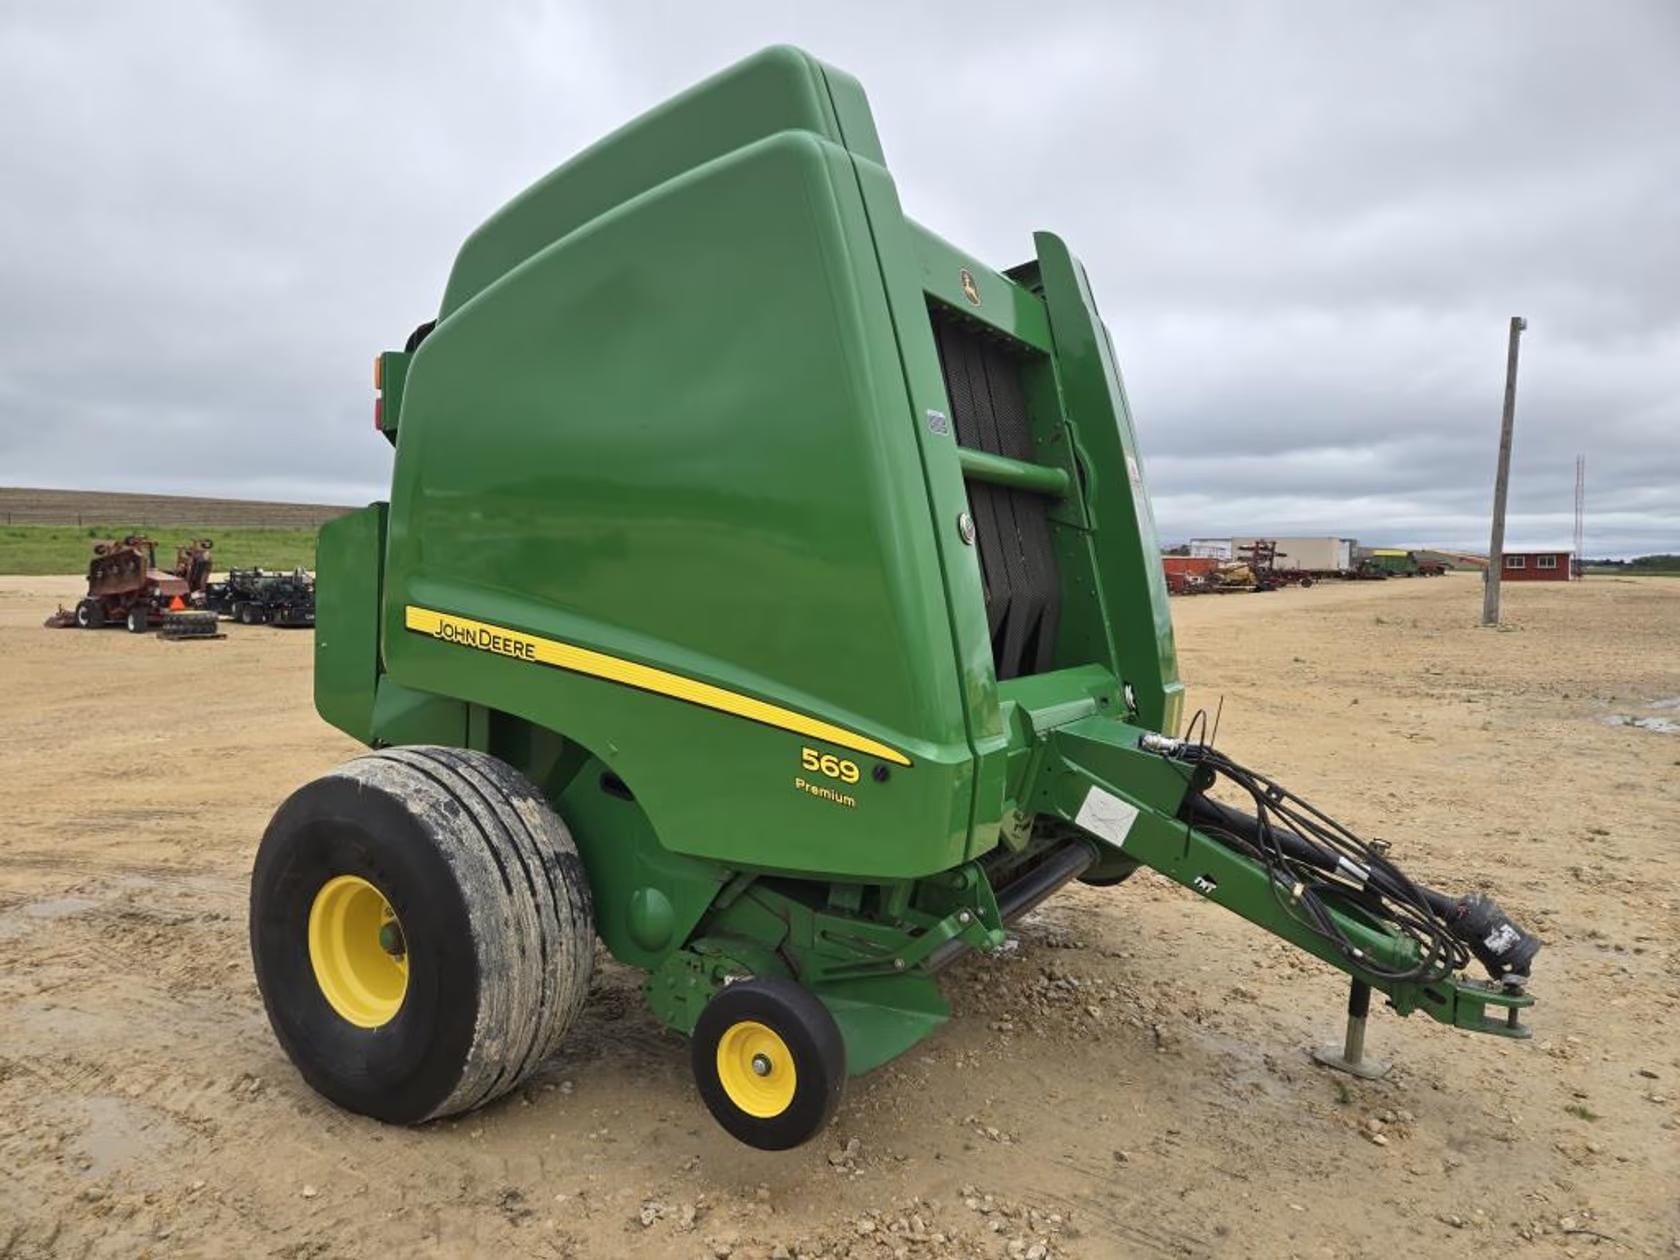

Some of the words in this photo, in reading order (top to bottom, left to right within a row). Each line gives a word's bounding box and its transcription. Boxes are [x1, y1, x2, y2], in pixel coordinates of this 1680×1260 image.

[434, 619, 477, 646] JOHN
[479, 628, 536, 660] DEERE
[802, 746, 860, 784] 569
[795, 777, 856, 808] Premium
